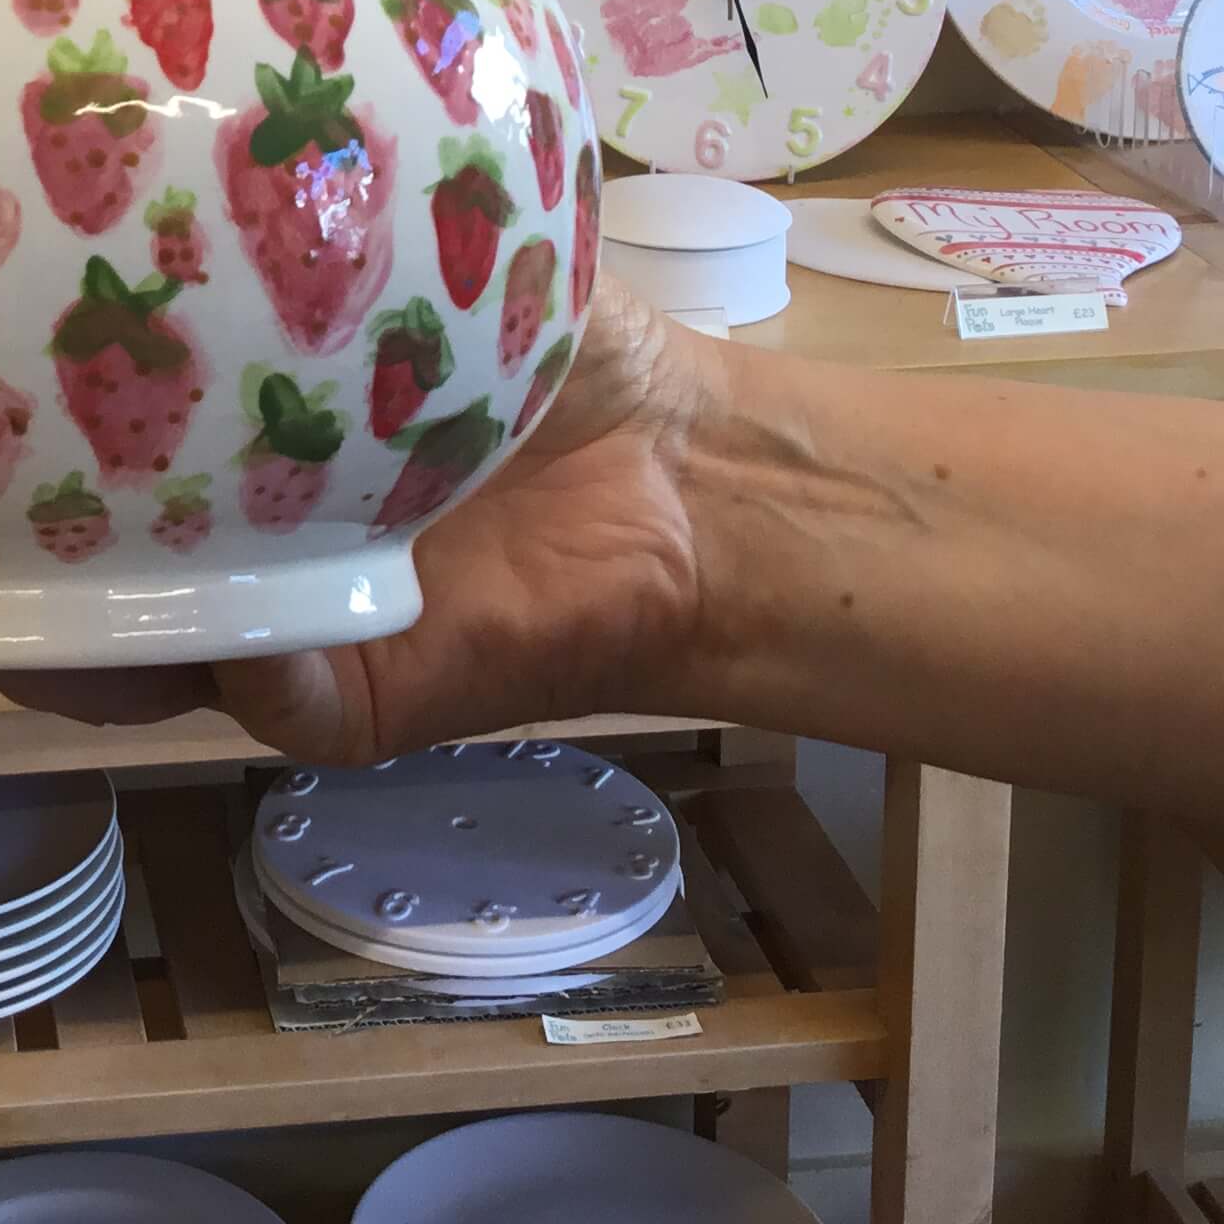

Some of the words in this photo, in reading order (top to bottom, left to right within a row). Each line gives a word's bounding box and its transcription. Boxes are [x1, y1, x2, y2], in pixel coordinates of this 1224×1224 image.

[856, 50, 894, 103] 4
[615, 86, 652, 138] 7
[694, 119, 732, 170] 6
[785, 107, 824, 158] 5
[908, 203, 1012, 240] My
[1018, 210, 1168, 236] Room
[964, 304, 988, 317] Fun
[1000, 309, 1025, 318] Large
[1028, 307, 1055, 316] Heart
[1073, 308, 1095, 319] £23
[965, 317, 995, 333] Pots
[503, 739, 561, 768] 12
[275, 814, 311, 842] 8
[626, 853, 660, 880] 3
